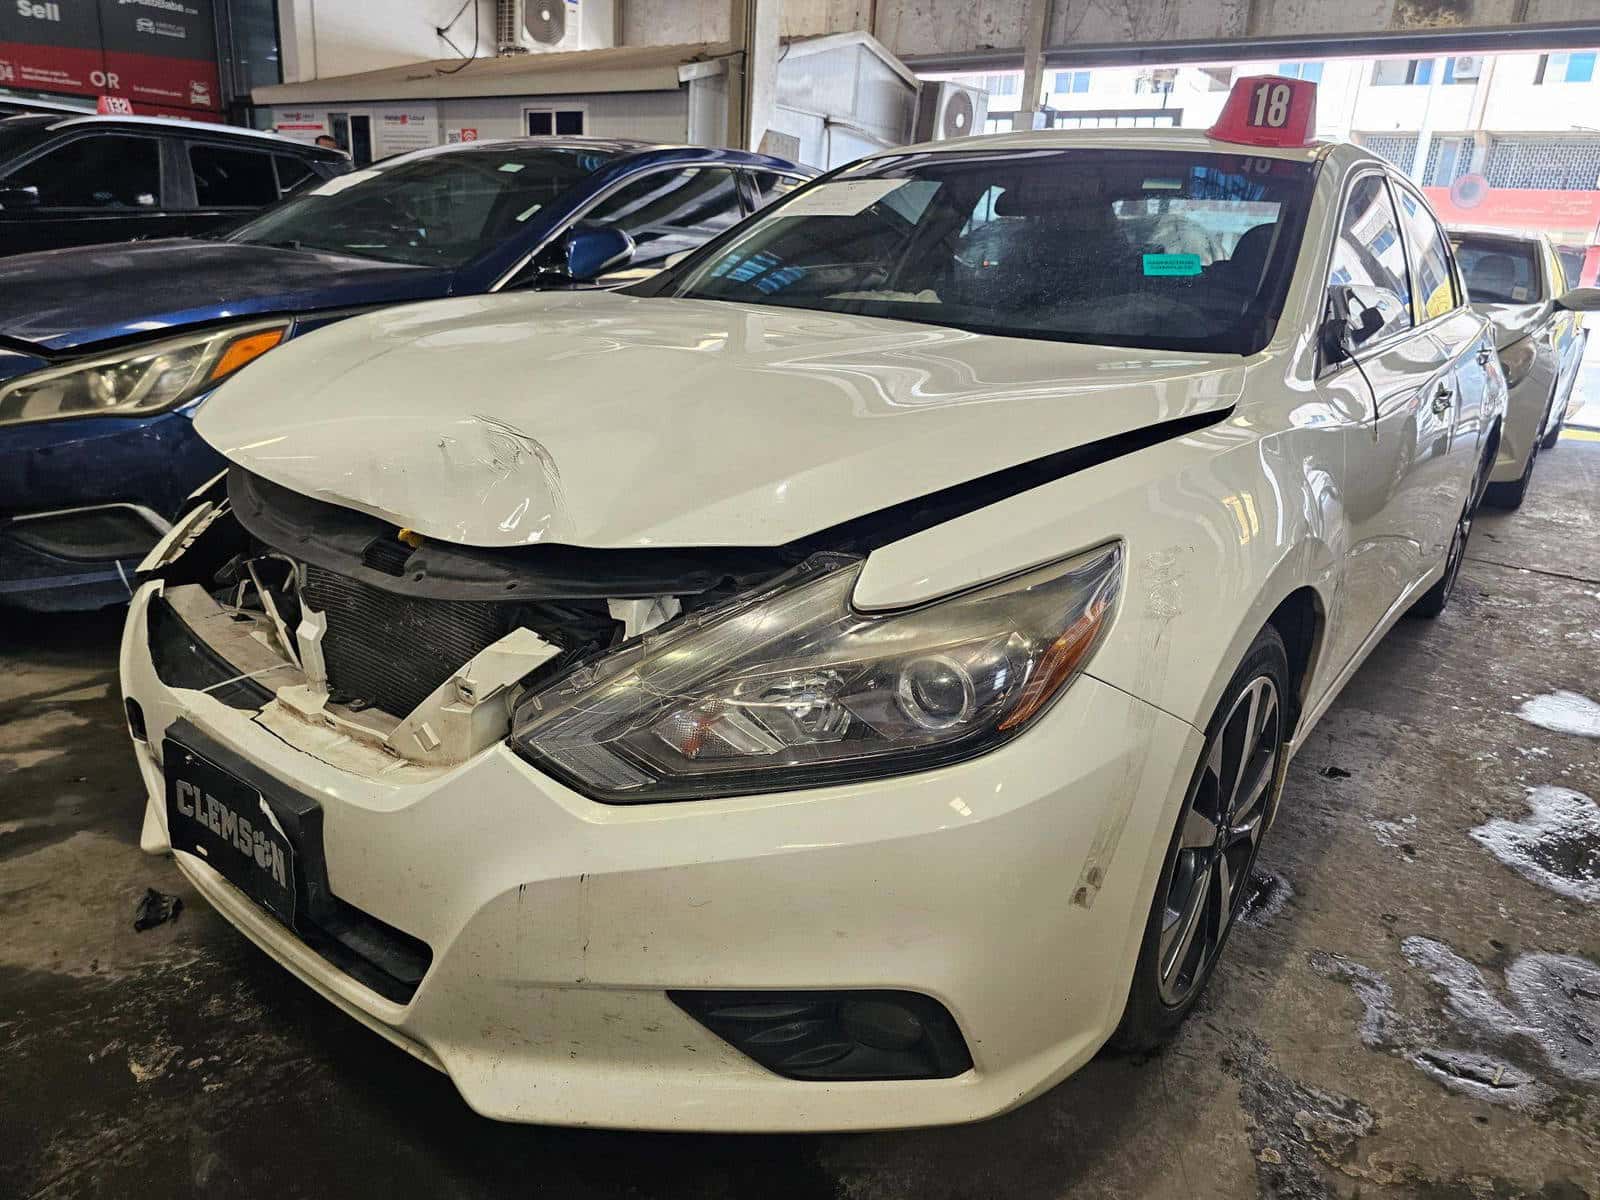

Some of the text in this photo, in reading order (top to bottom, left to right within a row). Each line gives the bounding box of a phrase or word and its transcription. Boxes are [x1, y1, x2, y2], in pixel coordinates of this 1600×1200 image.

[17, 0, 60, 21] Sell
[90, 71, 120, 89] OR
[106, 97, 129, 113] 132
[1254, 84, 1291, 127] 18
